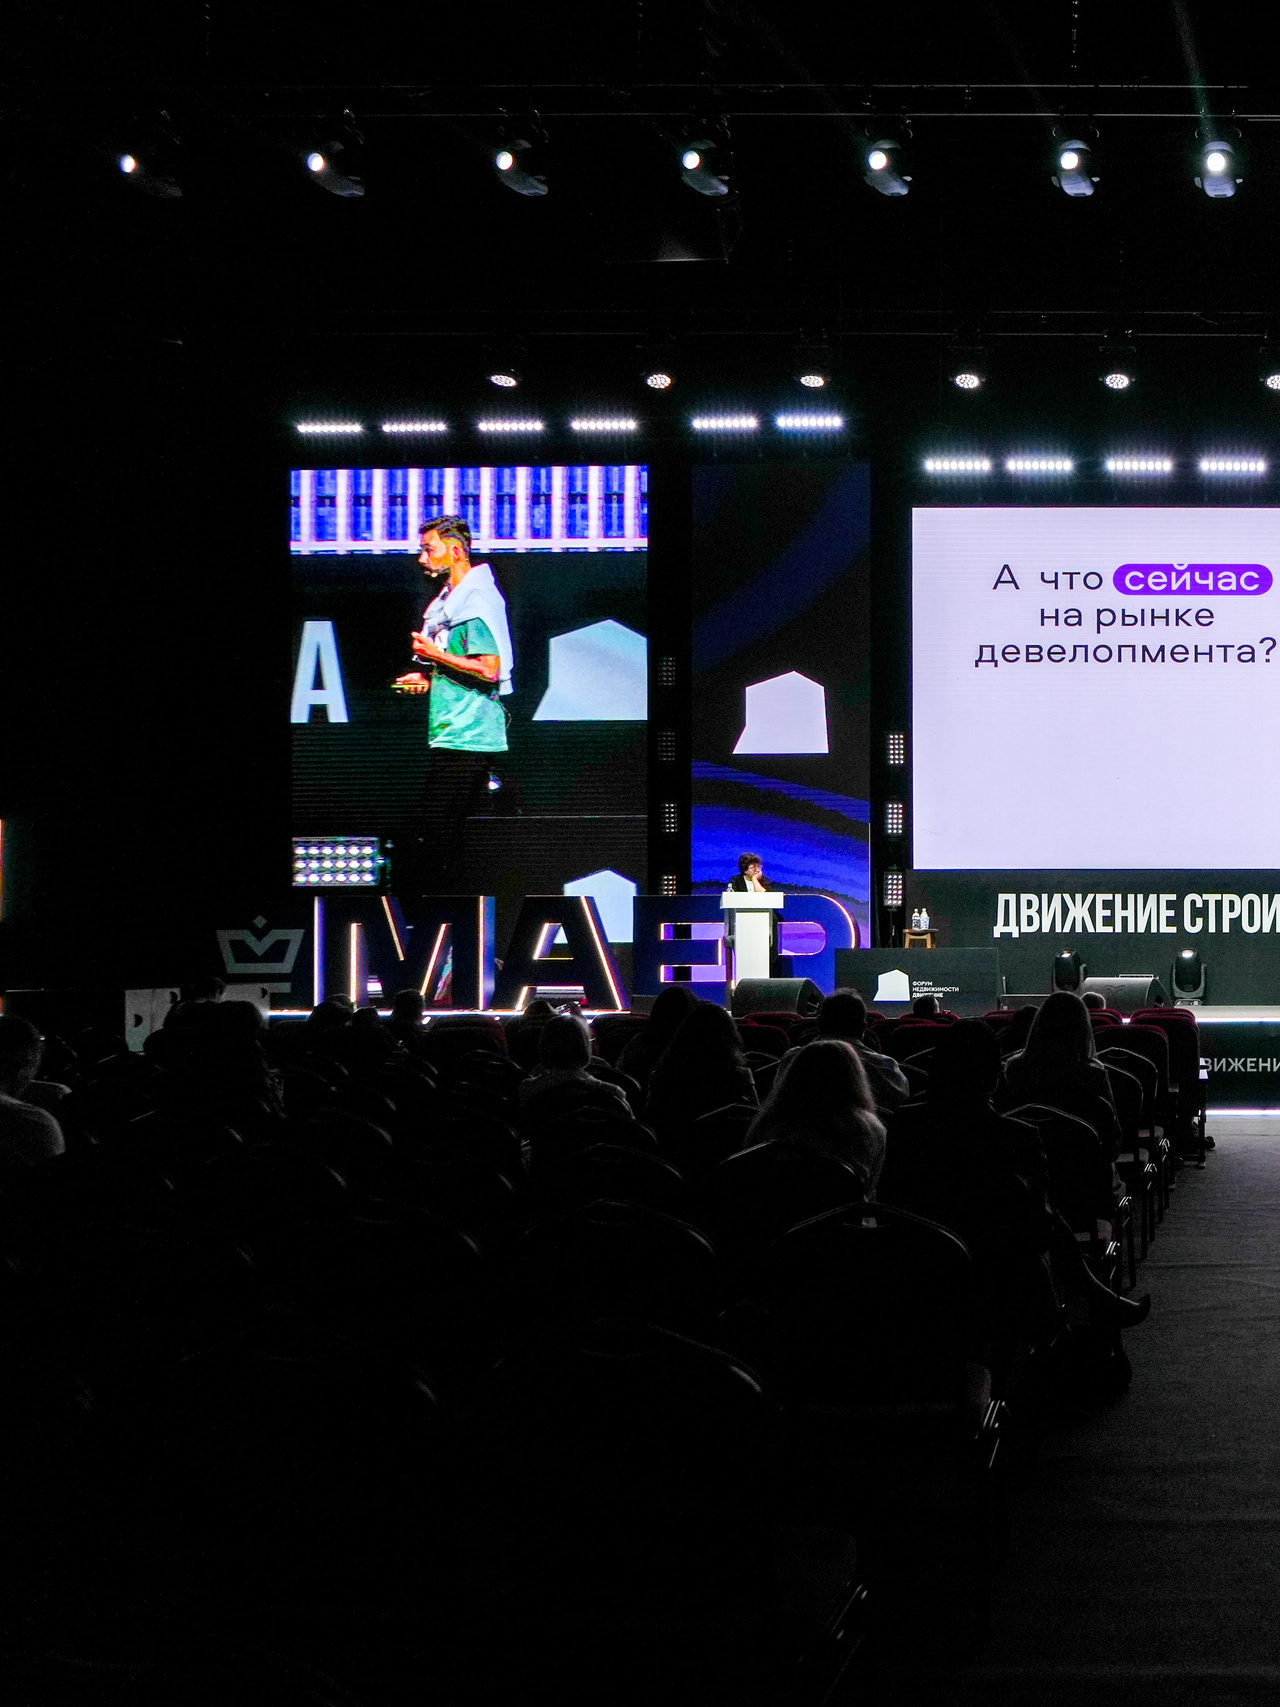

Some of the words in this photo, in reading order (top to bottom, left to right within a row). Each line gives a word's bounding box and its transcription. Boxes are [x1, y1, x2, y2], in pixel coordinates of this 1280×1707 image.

[992, 563, 1020, 591] А
[1040, 571, 1104, 591] что
[1124, 563, 1261, 592] сейчас
[1040, 608, 1083, 627] на
[1096, 608, 1215, 634] рынке
[974, 636, 1277, 668] девелопмента?
[993, 893, 1177, 938] ДВИЖЕНИЕ
